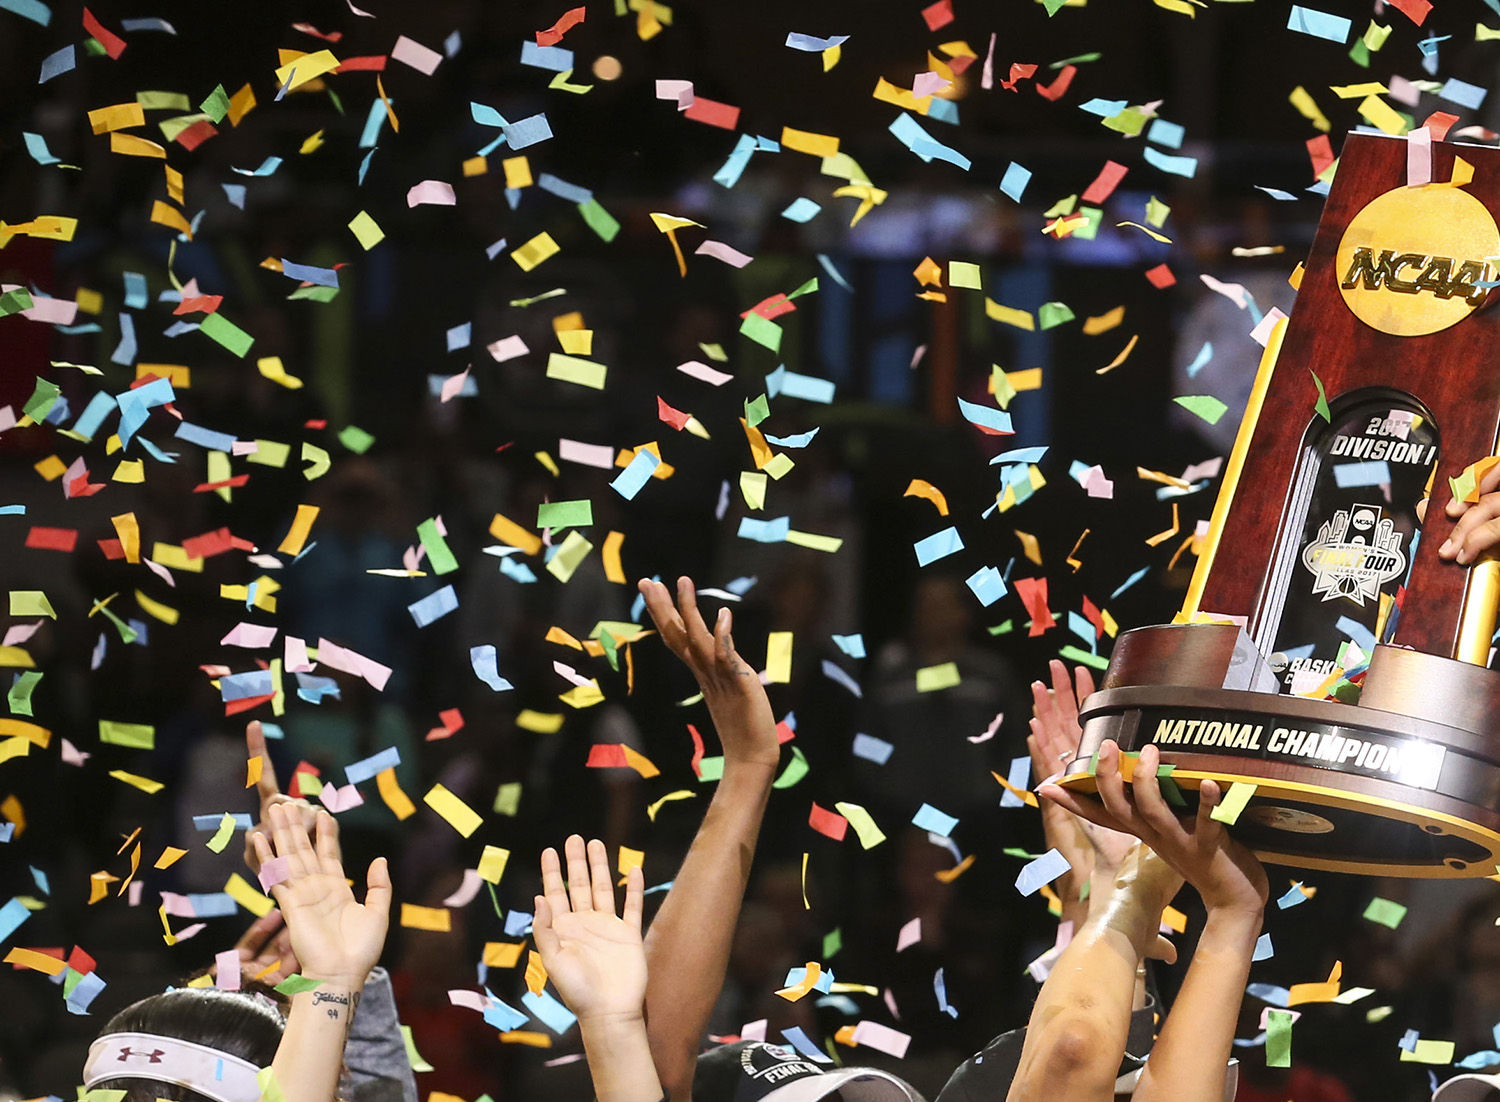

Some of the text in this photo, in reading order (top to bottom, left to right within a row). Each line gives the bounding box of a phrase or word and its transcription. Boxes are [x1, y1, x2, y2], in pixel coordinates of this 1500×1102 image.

[1341, 246, 1490, 307] NCAA
[1330, 435, 1424, 464] DIVISION
[1354, 554, 1397, 573] FOUR
[1152, 719, 1402, 775] NATIONAL CHAMPION
[764, 1063, 808, 1084] FINAL
